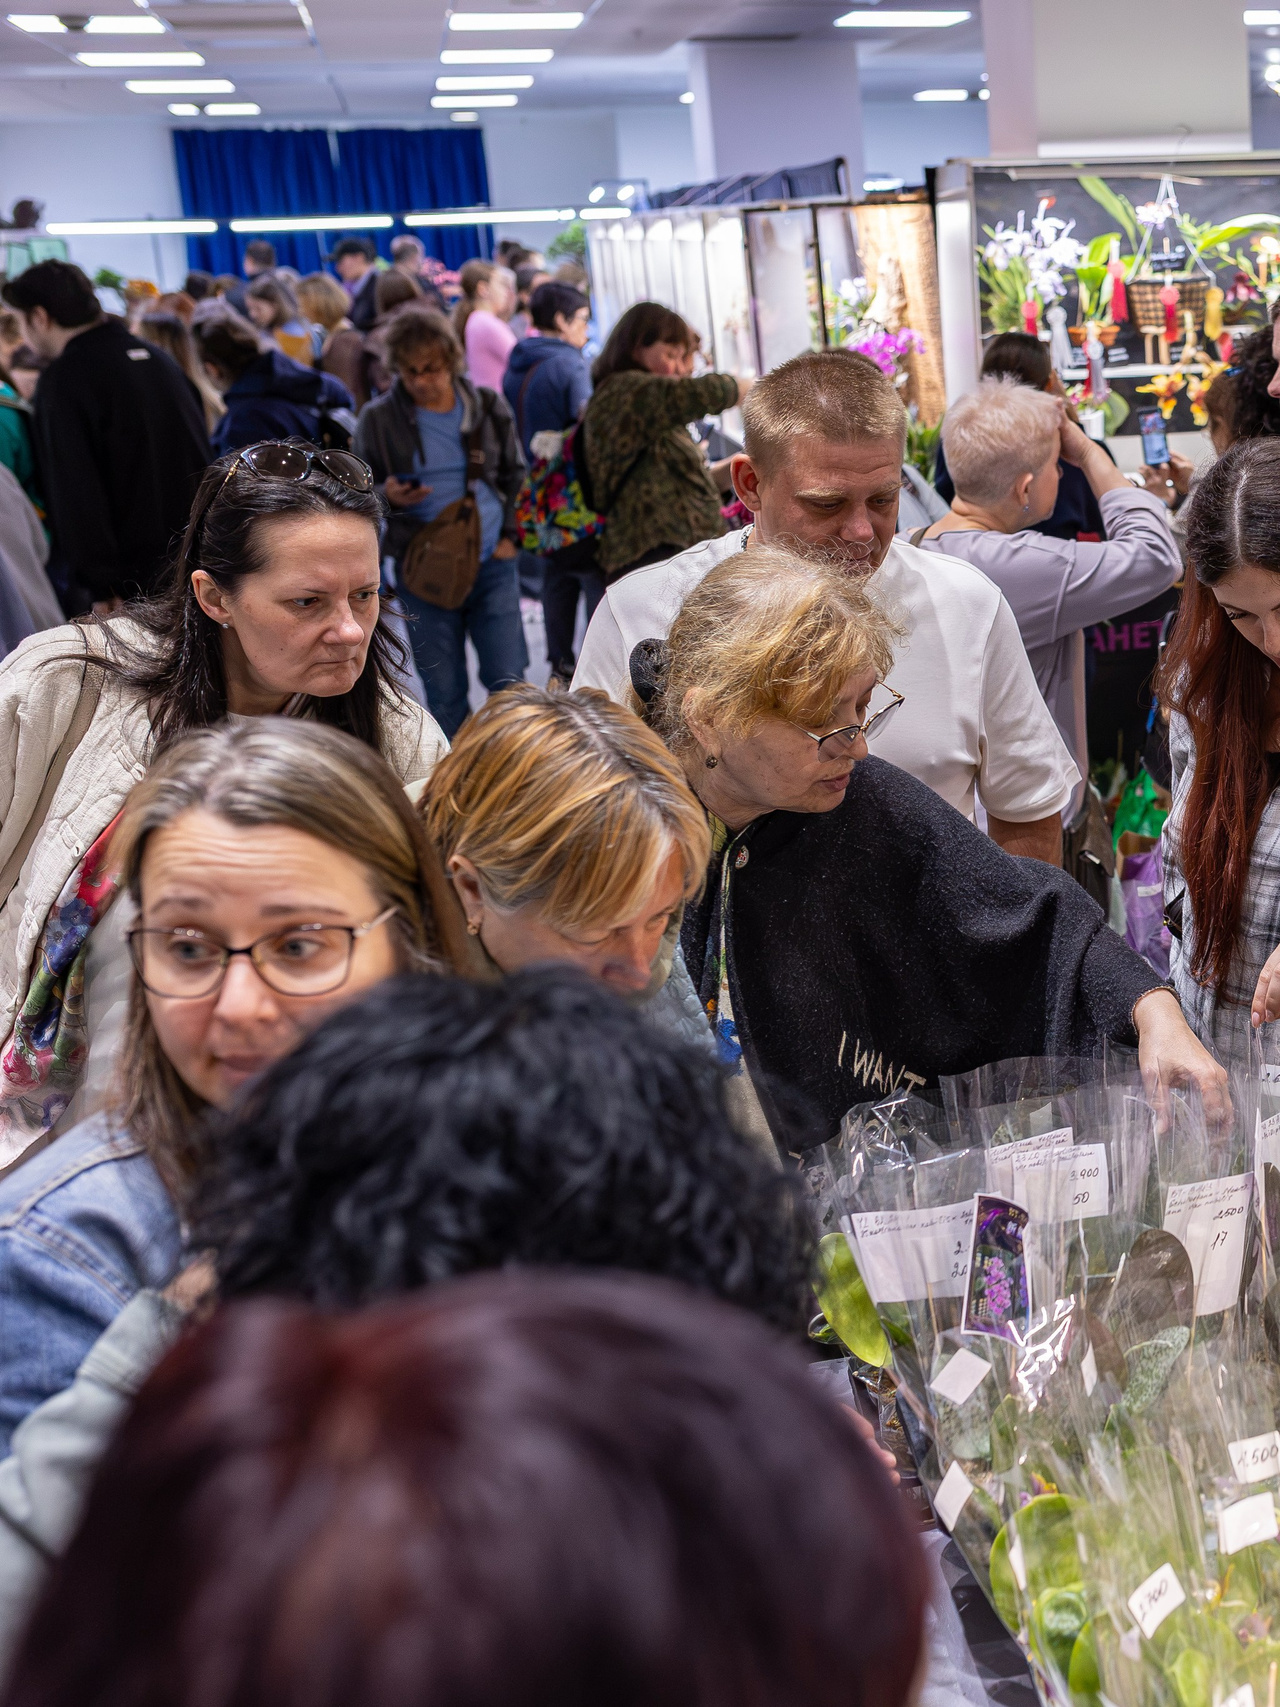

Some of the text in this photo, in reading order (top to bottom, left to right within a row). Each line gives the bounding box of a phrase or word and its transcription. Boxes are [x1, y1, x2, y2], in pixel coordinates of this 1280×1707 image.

[838, 1030, 927, 1099] I WANT
[1073, 1191, 1090, 1206] 50
[1210, 1231, 1228, 1250] 17
